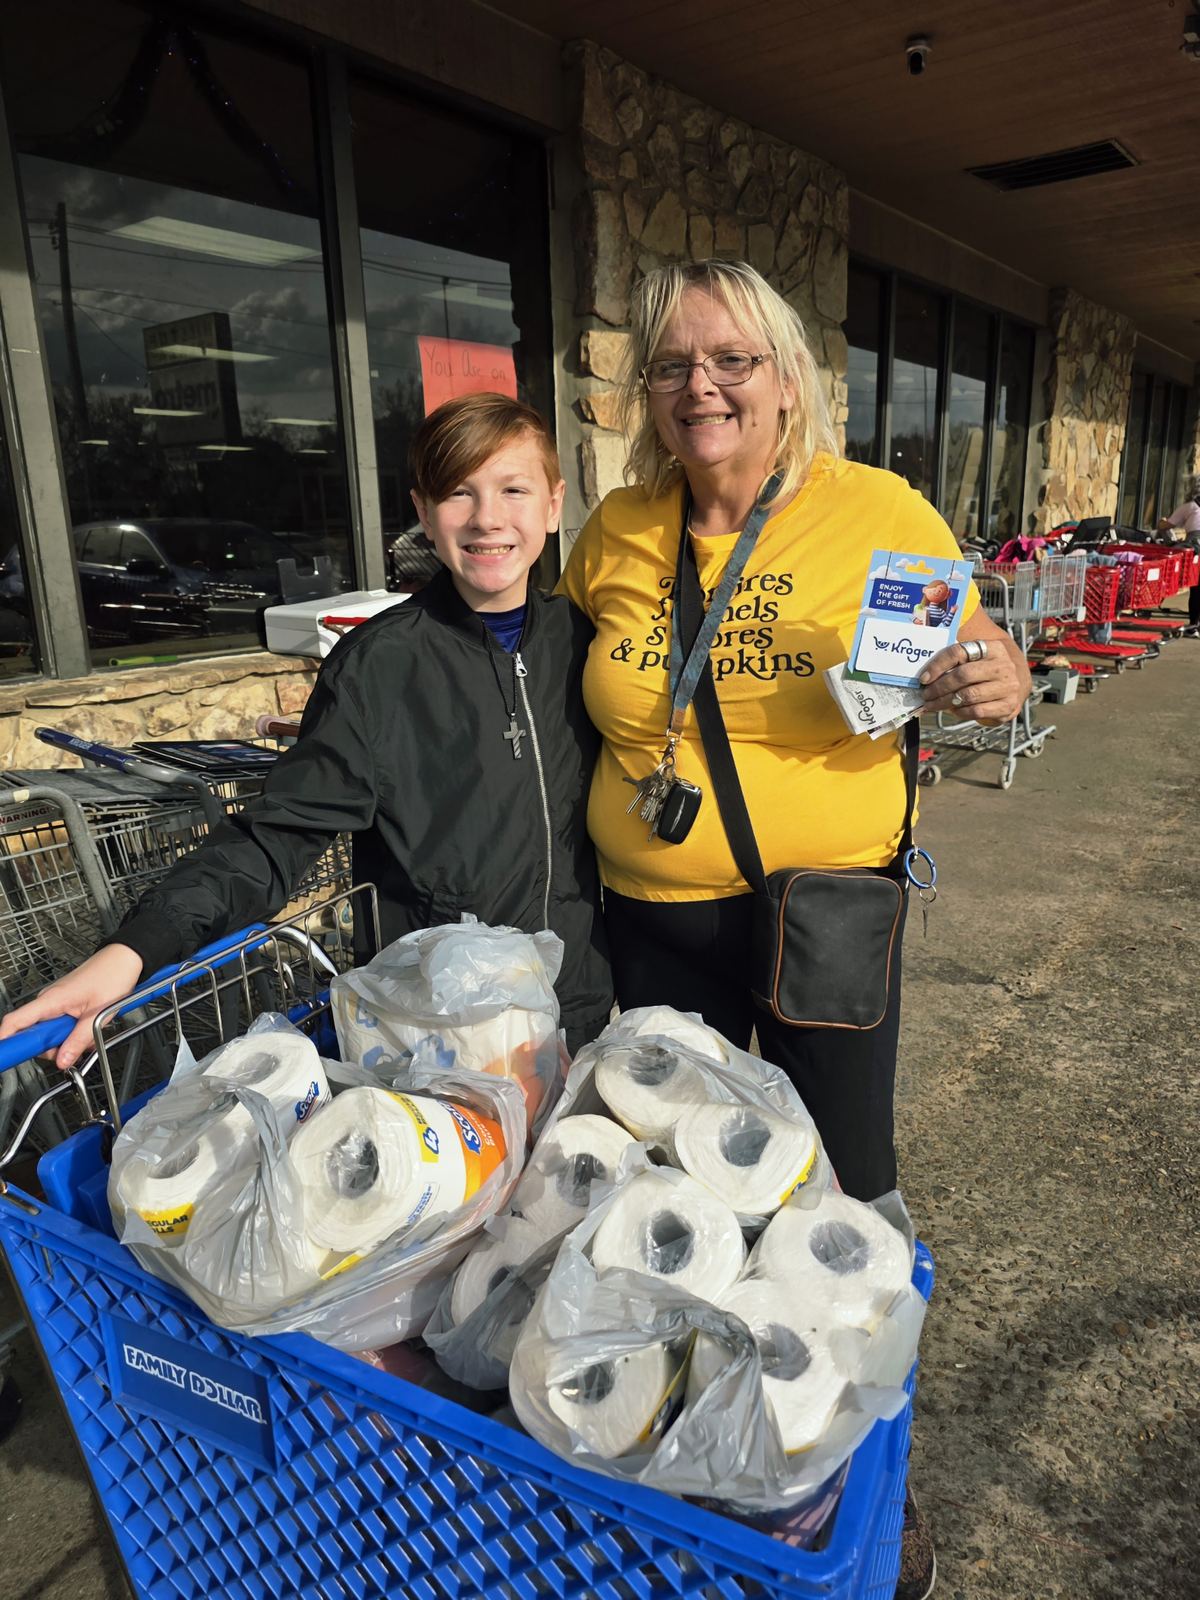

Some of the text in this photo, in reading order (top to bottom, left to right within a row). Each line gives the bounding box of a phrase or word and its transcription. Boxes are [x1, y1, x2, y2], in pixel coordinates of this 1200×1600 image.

[424, 344, 454, 377] You
[490, 368, 506, 381] on
[878, 591, 910, 601] THE GIFT
[879, 583, 904, 592] ENJOY
[887, 600, 911, 609] FRESH
[610, 637, 636, 662] &
[891, 638, 935, 663] Kroger
[854, 690, 876, 725] Kroger
[123, 1343, 263, 1424] FAMILY DOLLAR
